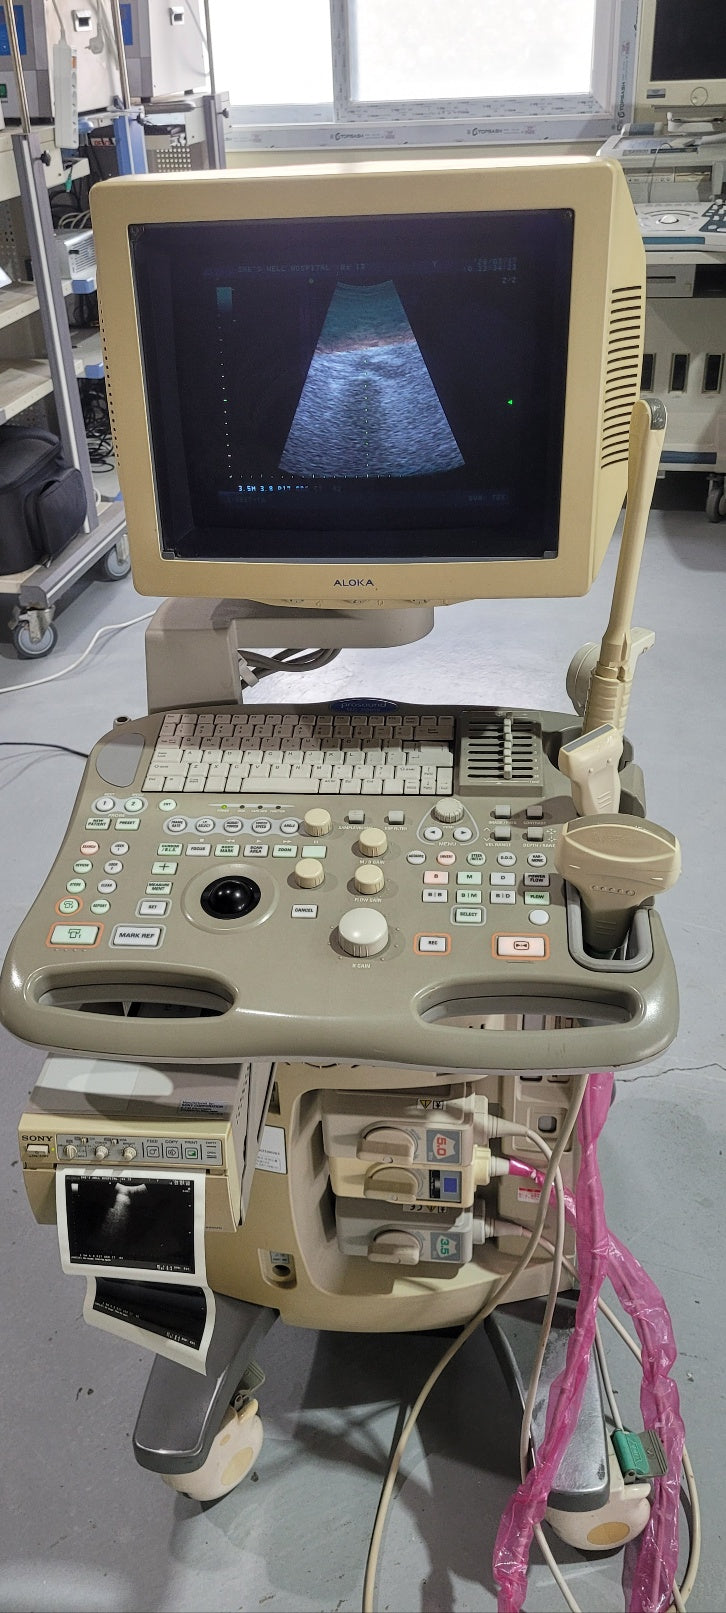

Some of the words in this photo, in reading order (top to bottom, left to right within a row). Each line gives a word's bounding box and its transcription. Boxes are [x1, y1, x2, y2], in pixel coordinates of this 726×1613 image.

[333, 579, 375, 587] ALOKA
[436, 1137, 447, 1157] 5.0
[440, 1238, 450, 1256] 3.5
